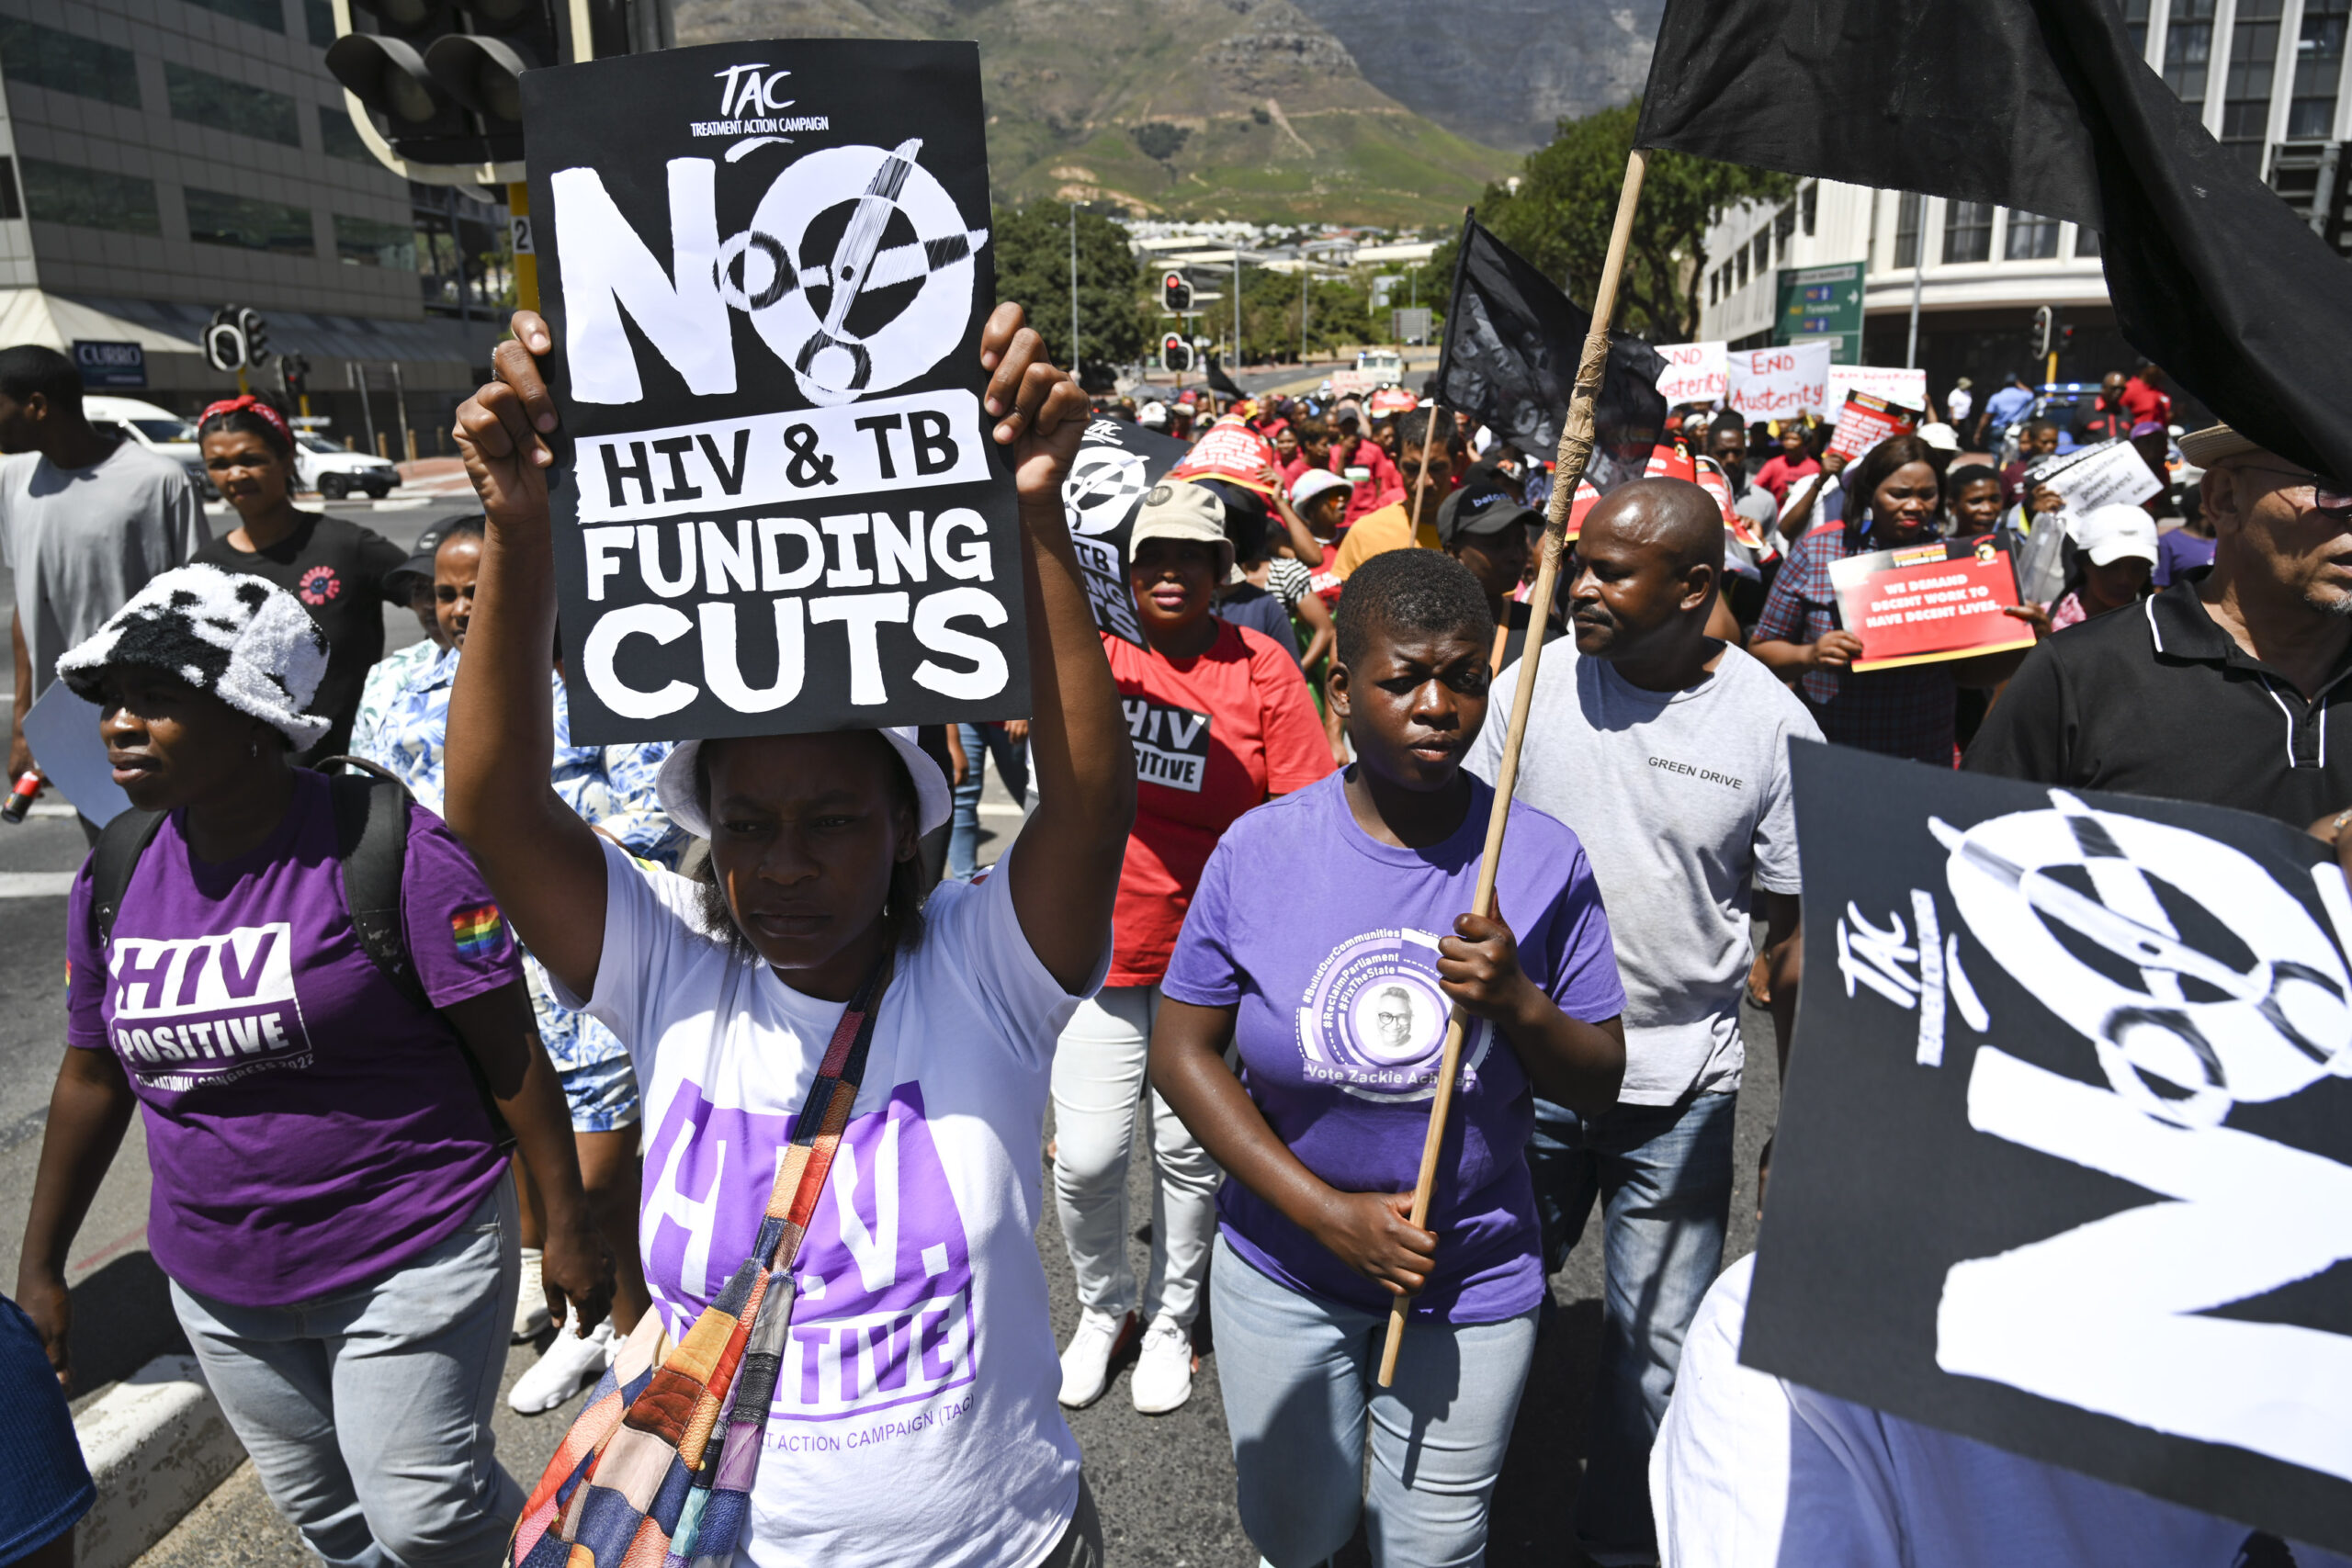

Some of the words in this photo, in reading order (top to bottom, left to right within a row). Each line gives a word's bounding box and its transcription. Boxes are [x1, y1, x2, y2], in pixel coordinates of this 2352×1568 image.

[714, 63, 796, 119] TAC
[690, 120, 742, 137] TREATMENT
[743, 118, 777, 133] ACTION
[778, 116, 830, 132] CAMPAIGN
[515, 220, 529, 250] 2
[551, 144, 976, 404] NO
[1659, 348, 1703, 367] ND
[1751, 352, 1795, 376] END
[1658, 372, 1727, 398] usterity
[1731, 383, 1825, 412] Austerity
[598, 428, 751, 507] HIV
[784, 423, 839, 489] &
[854, 410, 959, 479] TB
[2062, 453, 2124, 497] unicipalities
[582, 507, 994, 602] FUNDING
[1871, 595, 1922, 613] DECENT
[1924, 589, 1968, 604] WORK
[1969, 586, 1989, 599] TO
[1884, 582, 1906, 595] WE
[1908, 574, 1968, 592] DEMAND
[1866, 613, 1903, 628] HAVE
[1905, 606, 1956, 623] DECENT
[1958, 600, 2001, 615] LIVES.
[583, 586, 1010, 720] CUTS
[1122, 700, 1206, 750] HIV
[1135, 749, 1196, 784] ITIVE
[1648, 756, 1697, 777] GREEN
[1699, 769, 1743, 790] DRIVE
[119, 931, 279, 1010] HIV
[1302, 928, 1400, 1004] #BuildOurCommunities
[1837, 899, 1921, 1010] TAC
[1322, 953, 1399, 1029] #ReclaimParliament
[1338, 965, 1396, 1011] #FixTheState
[117, 1011, 289, 1064] POSITIVE
[154, 1076, 198, 1092] NATIONAL
[198, 1061, 276, 1087] CONGRESS
[1306, 1064, 1344, 1080] Vote
[1348, 1067, 1404, 1084] Zackie
[1407, 1071, 1473, 1088] Achat
[640, 1116, 951, 1299] H..V.
[777, 1433, 841, 1452] ACTION
[846, 1410, 934, 1450] CAMPAIGN
[938, 1393, 975, 1426] (TAC)
